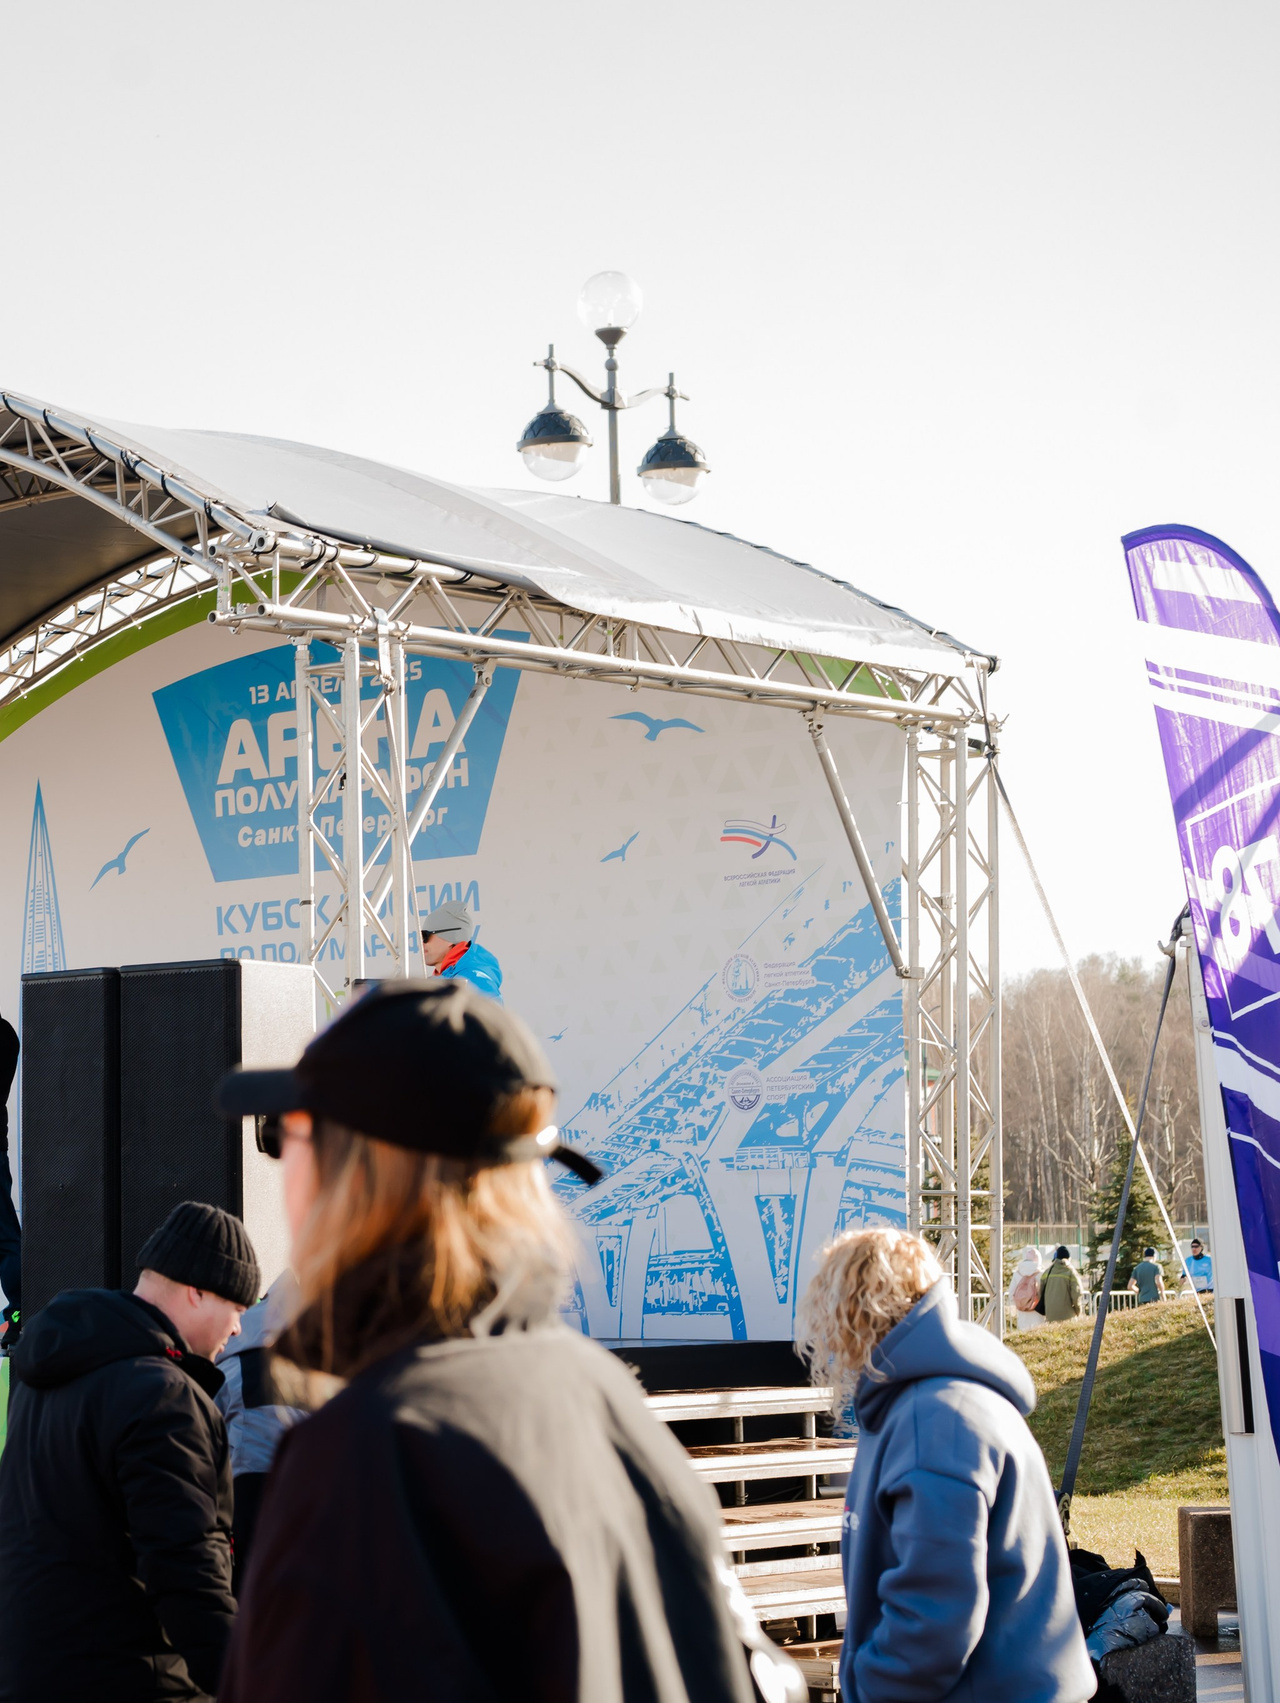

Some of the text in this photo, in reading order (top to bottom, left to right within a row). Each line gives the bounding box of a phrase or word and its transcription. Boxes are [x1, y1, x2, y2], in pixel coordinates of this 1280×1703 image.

[249, 684, 270, 705] 13
[723, 871, 767, 882] ВСЕРОССИЙСКАЯ
[766, 1074, 808, 1083] АССОЦИАЦИЯ
[766, 1082, 816, 1092] ПЕТЕРБУРГСКИЙ
[766, 1094, 787, 1102] СПОРТ
